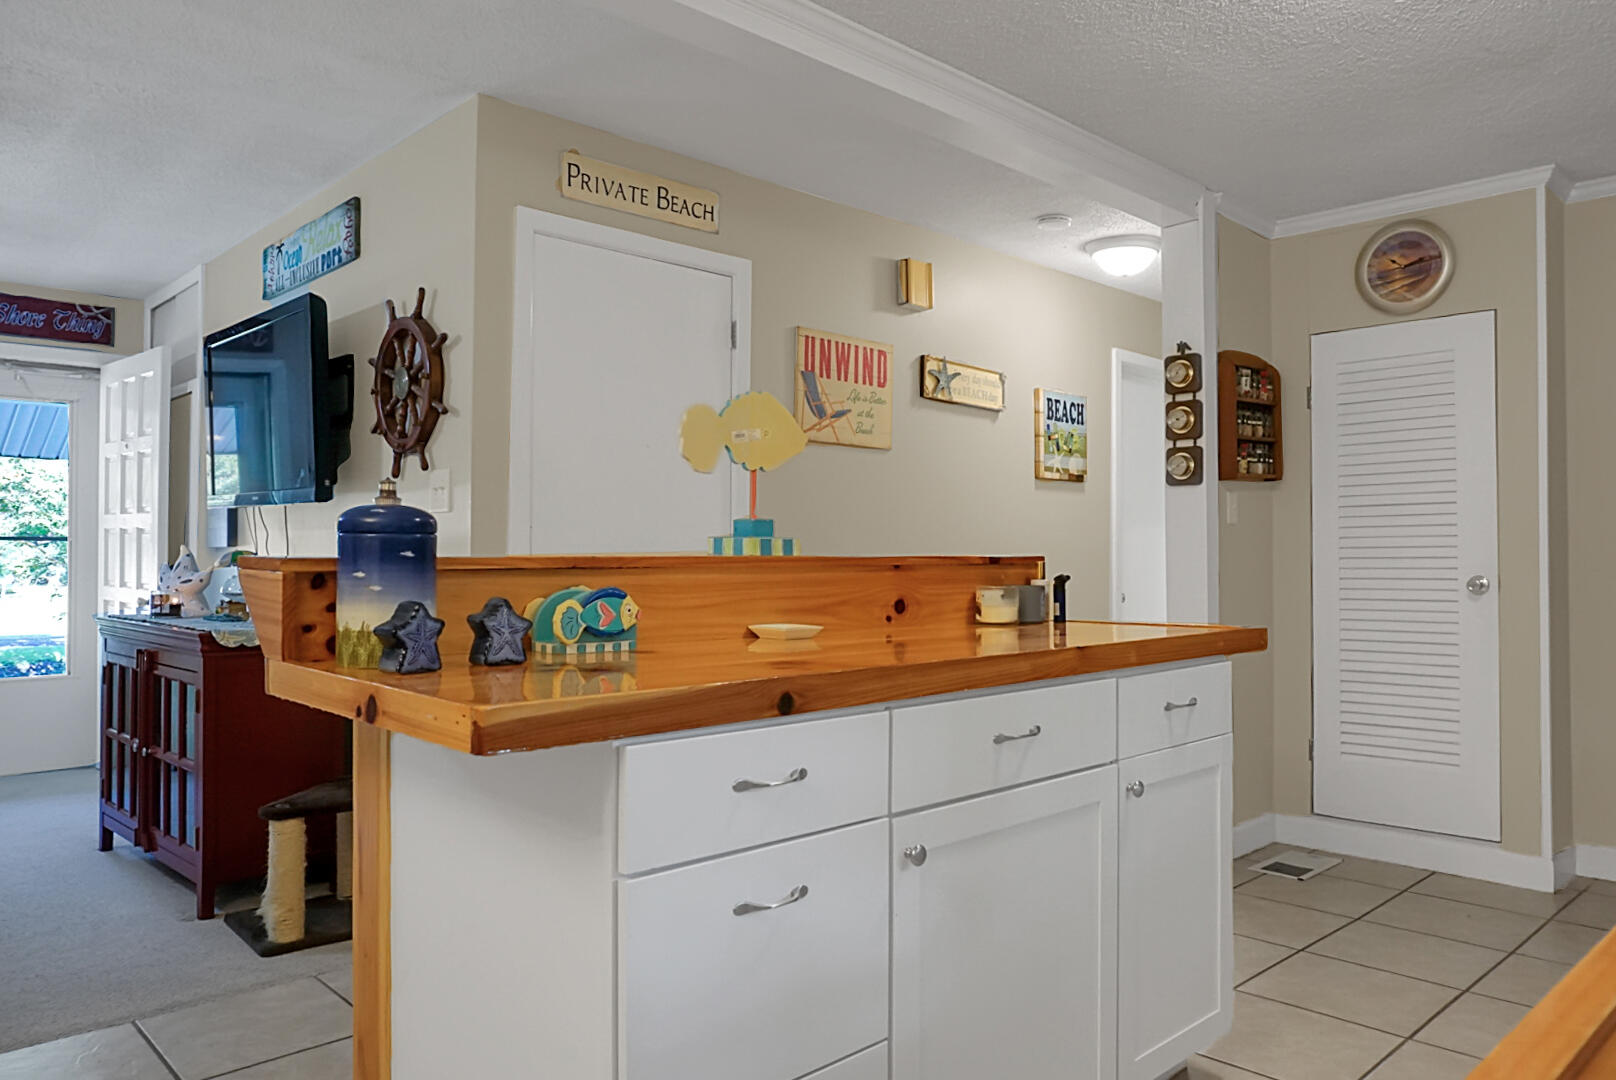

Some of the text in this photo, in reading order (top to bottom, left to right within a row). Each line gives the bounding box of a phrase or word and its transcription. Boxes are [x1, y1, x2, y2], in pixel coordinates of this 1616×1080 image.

[567, 162, 715, 222] PRIVATE BEACH
[0, 302, 105, 340] Shore Thing
[804, 335, 888, 388] UNWIND
[1046, 397, 1085, 426] BEACH
